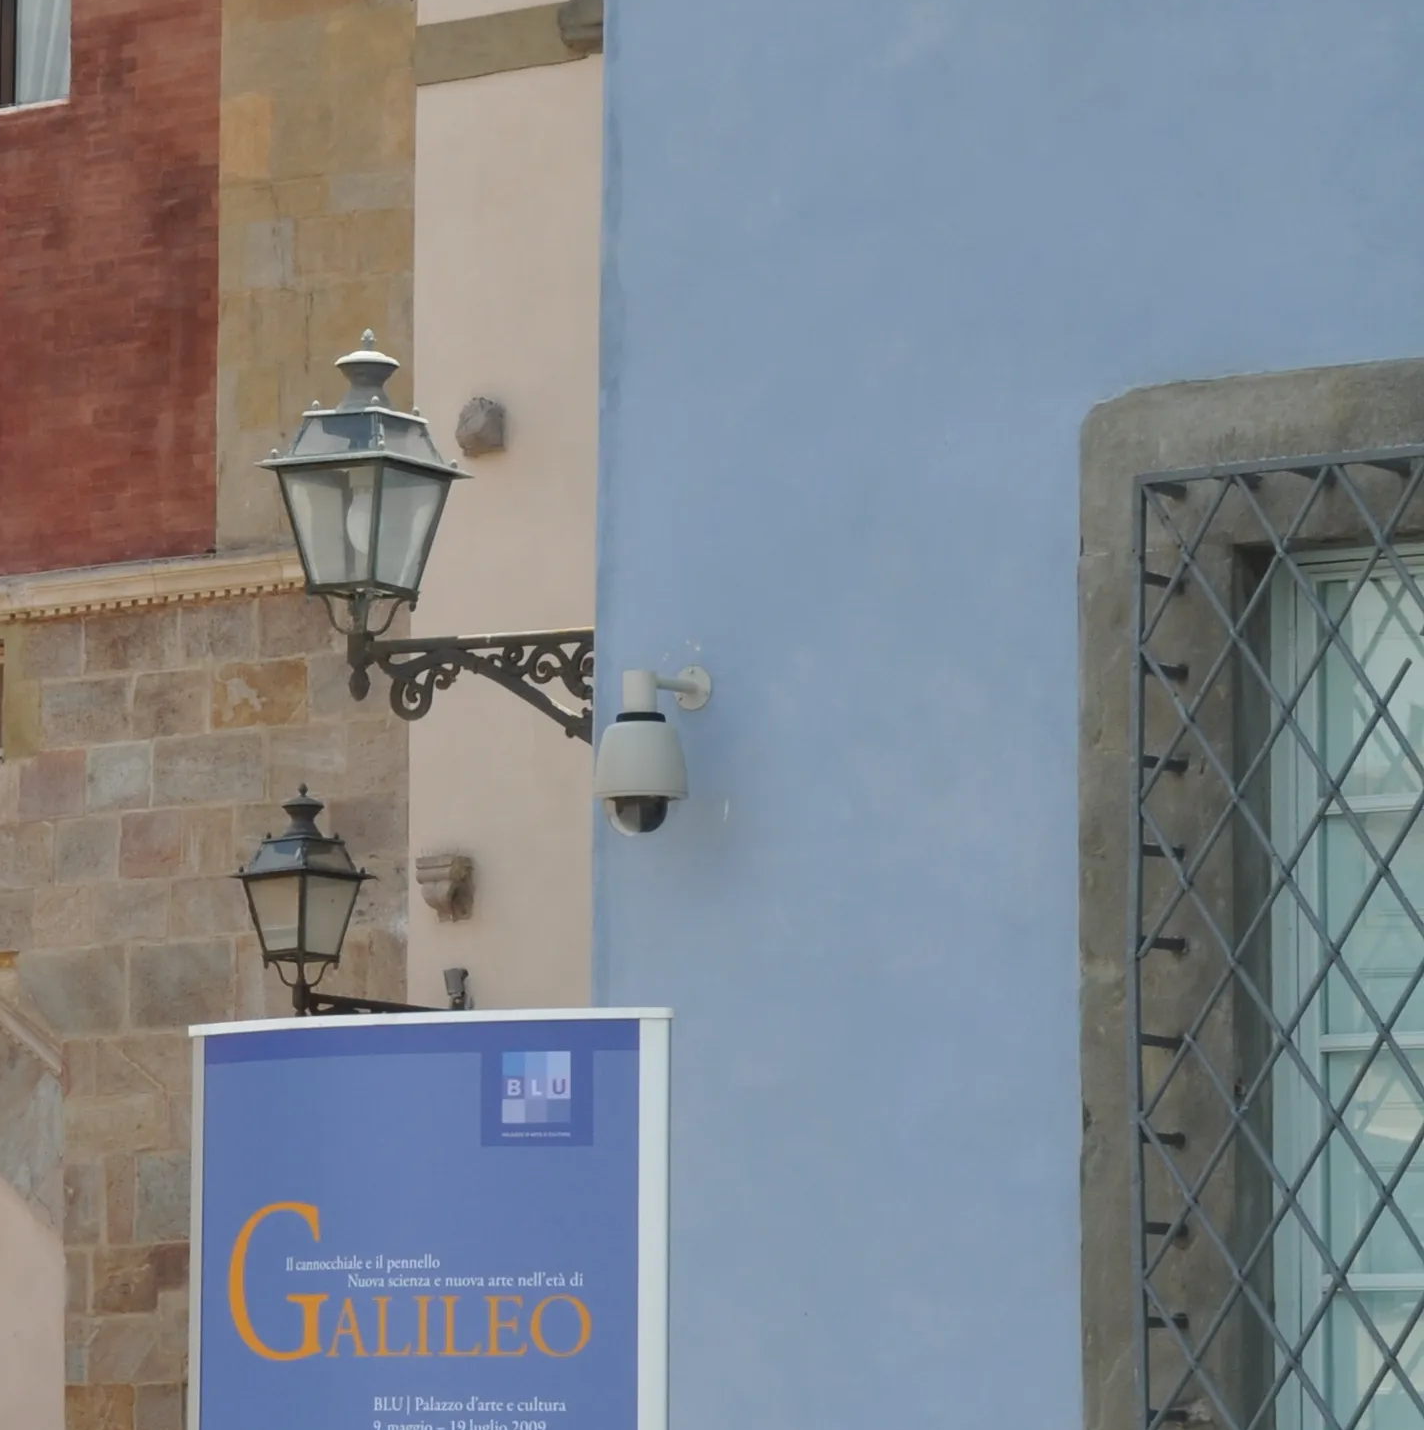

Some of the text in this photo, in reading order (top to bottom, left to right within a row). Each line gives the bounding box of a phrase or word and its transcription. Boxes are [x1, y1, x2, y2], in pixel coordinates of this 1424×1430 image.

[508, 1079, 566, 1096] BLU
[286, 1254, 440, 1273] Il cannocchiale e il pennello
[228, 1201, 592, 1361] GALILEO
[348, 1274, 385, 1288] Nuova
[388, 1274, 430, 1287] scienza
[434, 1276, 441, 1287] e
[445, 1276, 484, 1287] nuova
[488, 1275, 514, 1287] arte
[569, 1272, 584, 1287] di
[374, 1397, 403, 1412] BLU
[415, 1397, 463, 1412] Palazzo
[466, 1396, 505, 1412] d'arte
[507, 1402, 513, 1412] e
[517, 1397, 566, 1412] cultura
